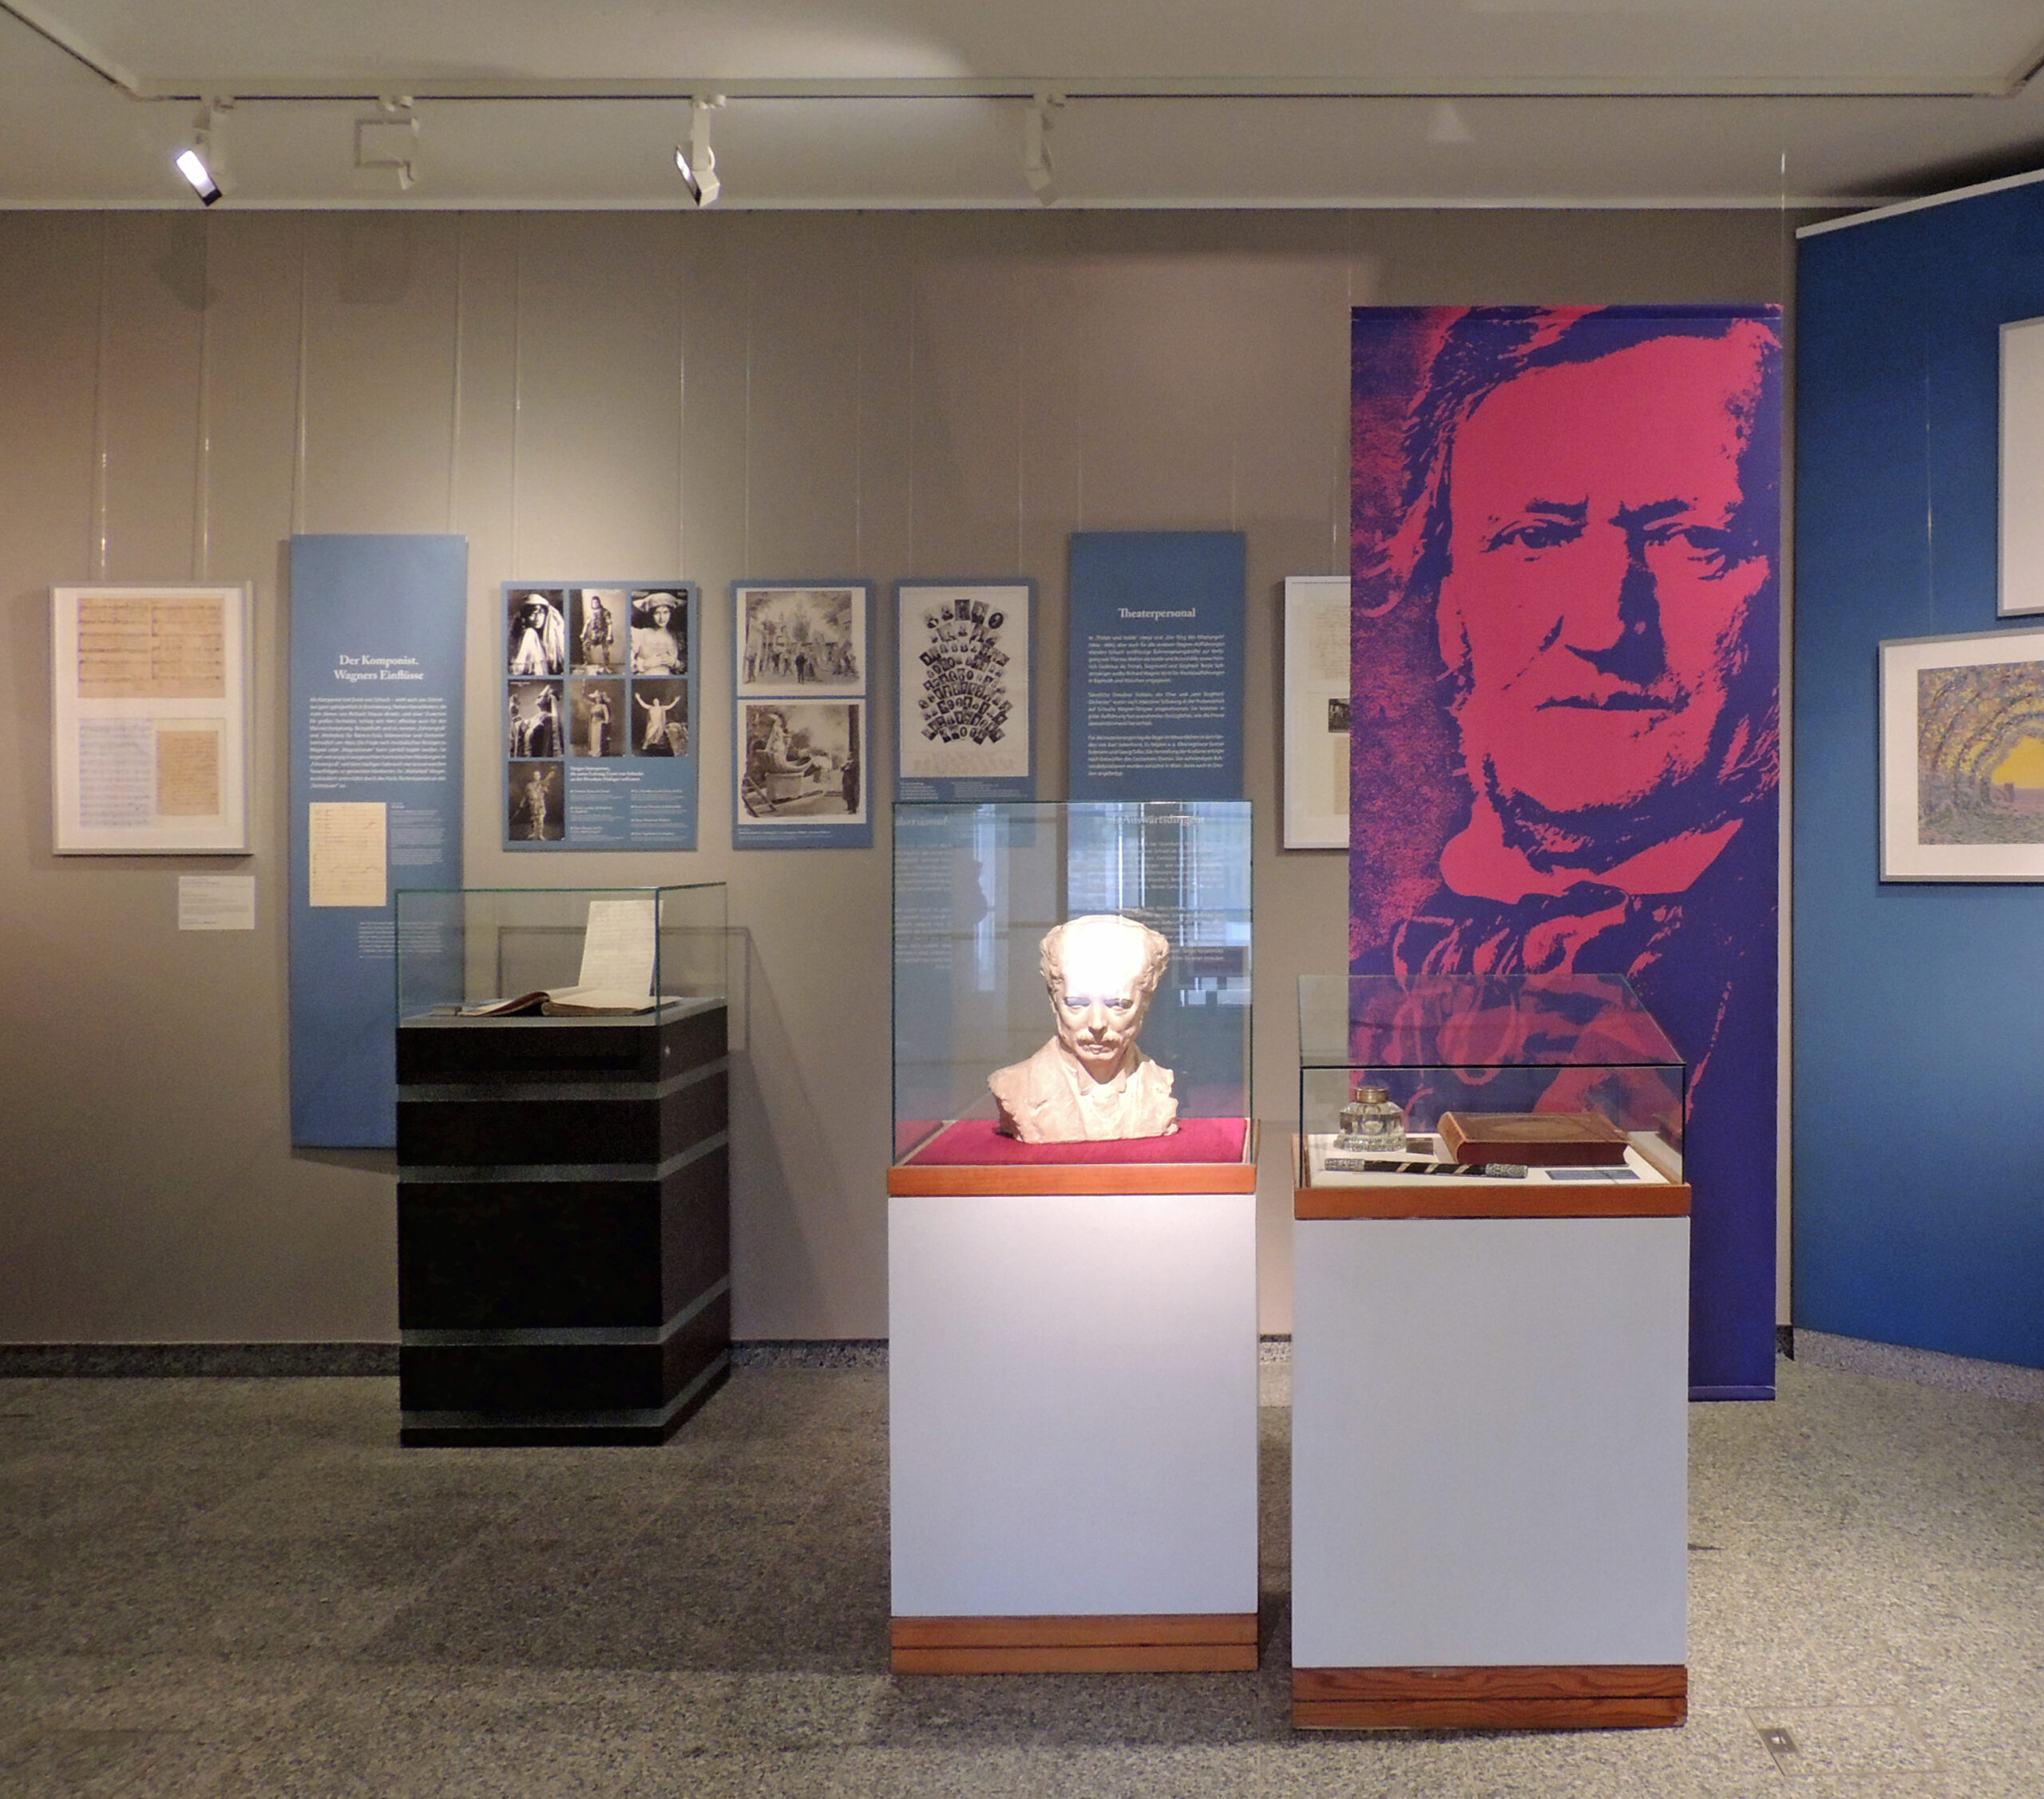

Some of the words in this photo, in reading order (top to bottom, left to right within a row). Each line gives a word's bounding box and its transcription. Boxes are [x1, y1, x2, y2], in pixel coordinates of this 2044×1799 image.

[1118, 608, 1196, 621] Theaterpersonal
[339, 655, 360, 665] Der
[362, 655, 419, 668] Komponist.
[334, 669, 378, 683] Wagners
[380, 669, 424, 680] Einflüsse
[1123, 814, 1205, 827] Auswärtsdirgent
